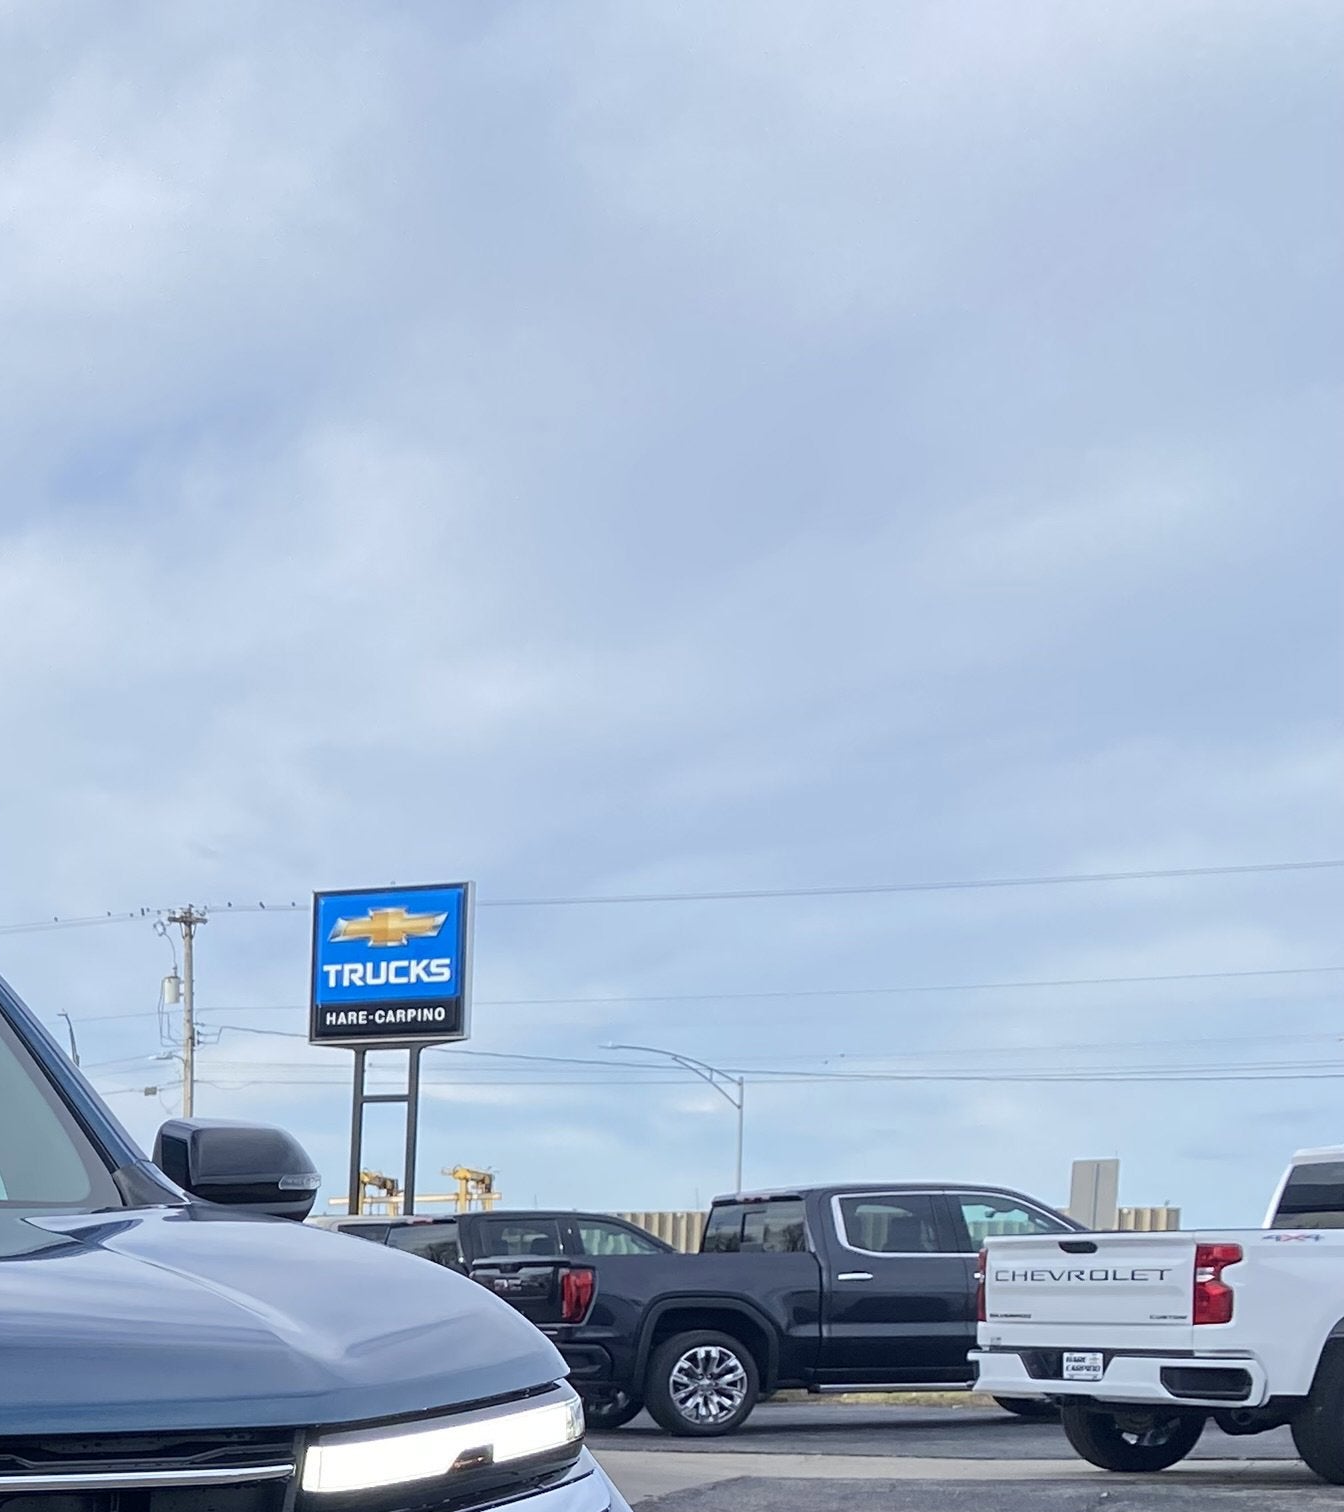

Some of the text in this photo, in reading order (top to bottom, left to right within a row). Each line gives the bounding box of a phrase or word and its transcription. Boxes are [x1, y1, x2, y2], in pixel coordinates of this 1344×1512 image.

[323, 957, 451, 988] TRUCKS
[325, 1007, 446, 1026] HARE-CARPINO
[995, 1268, 1173, 1282] CHEVROLET
